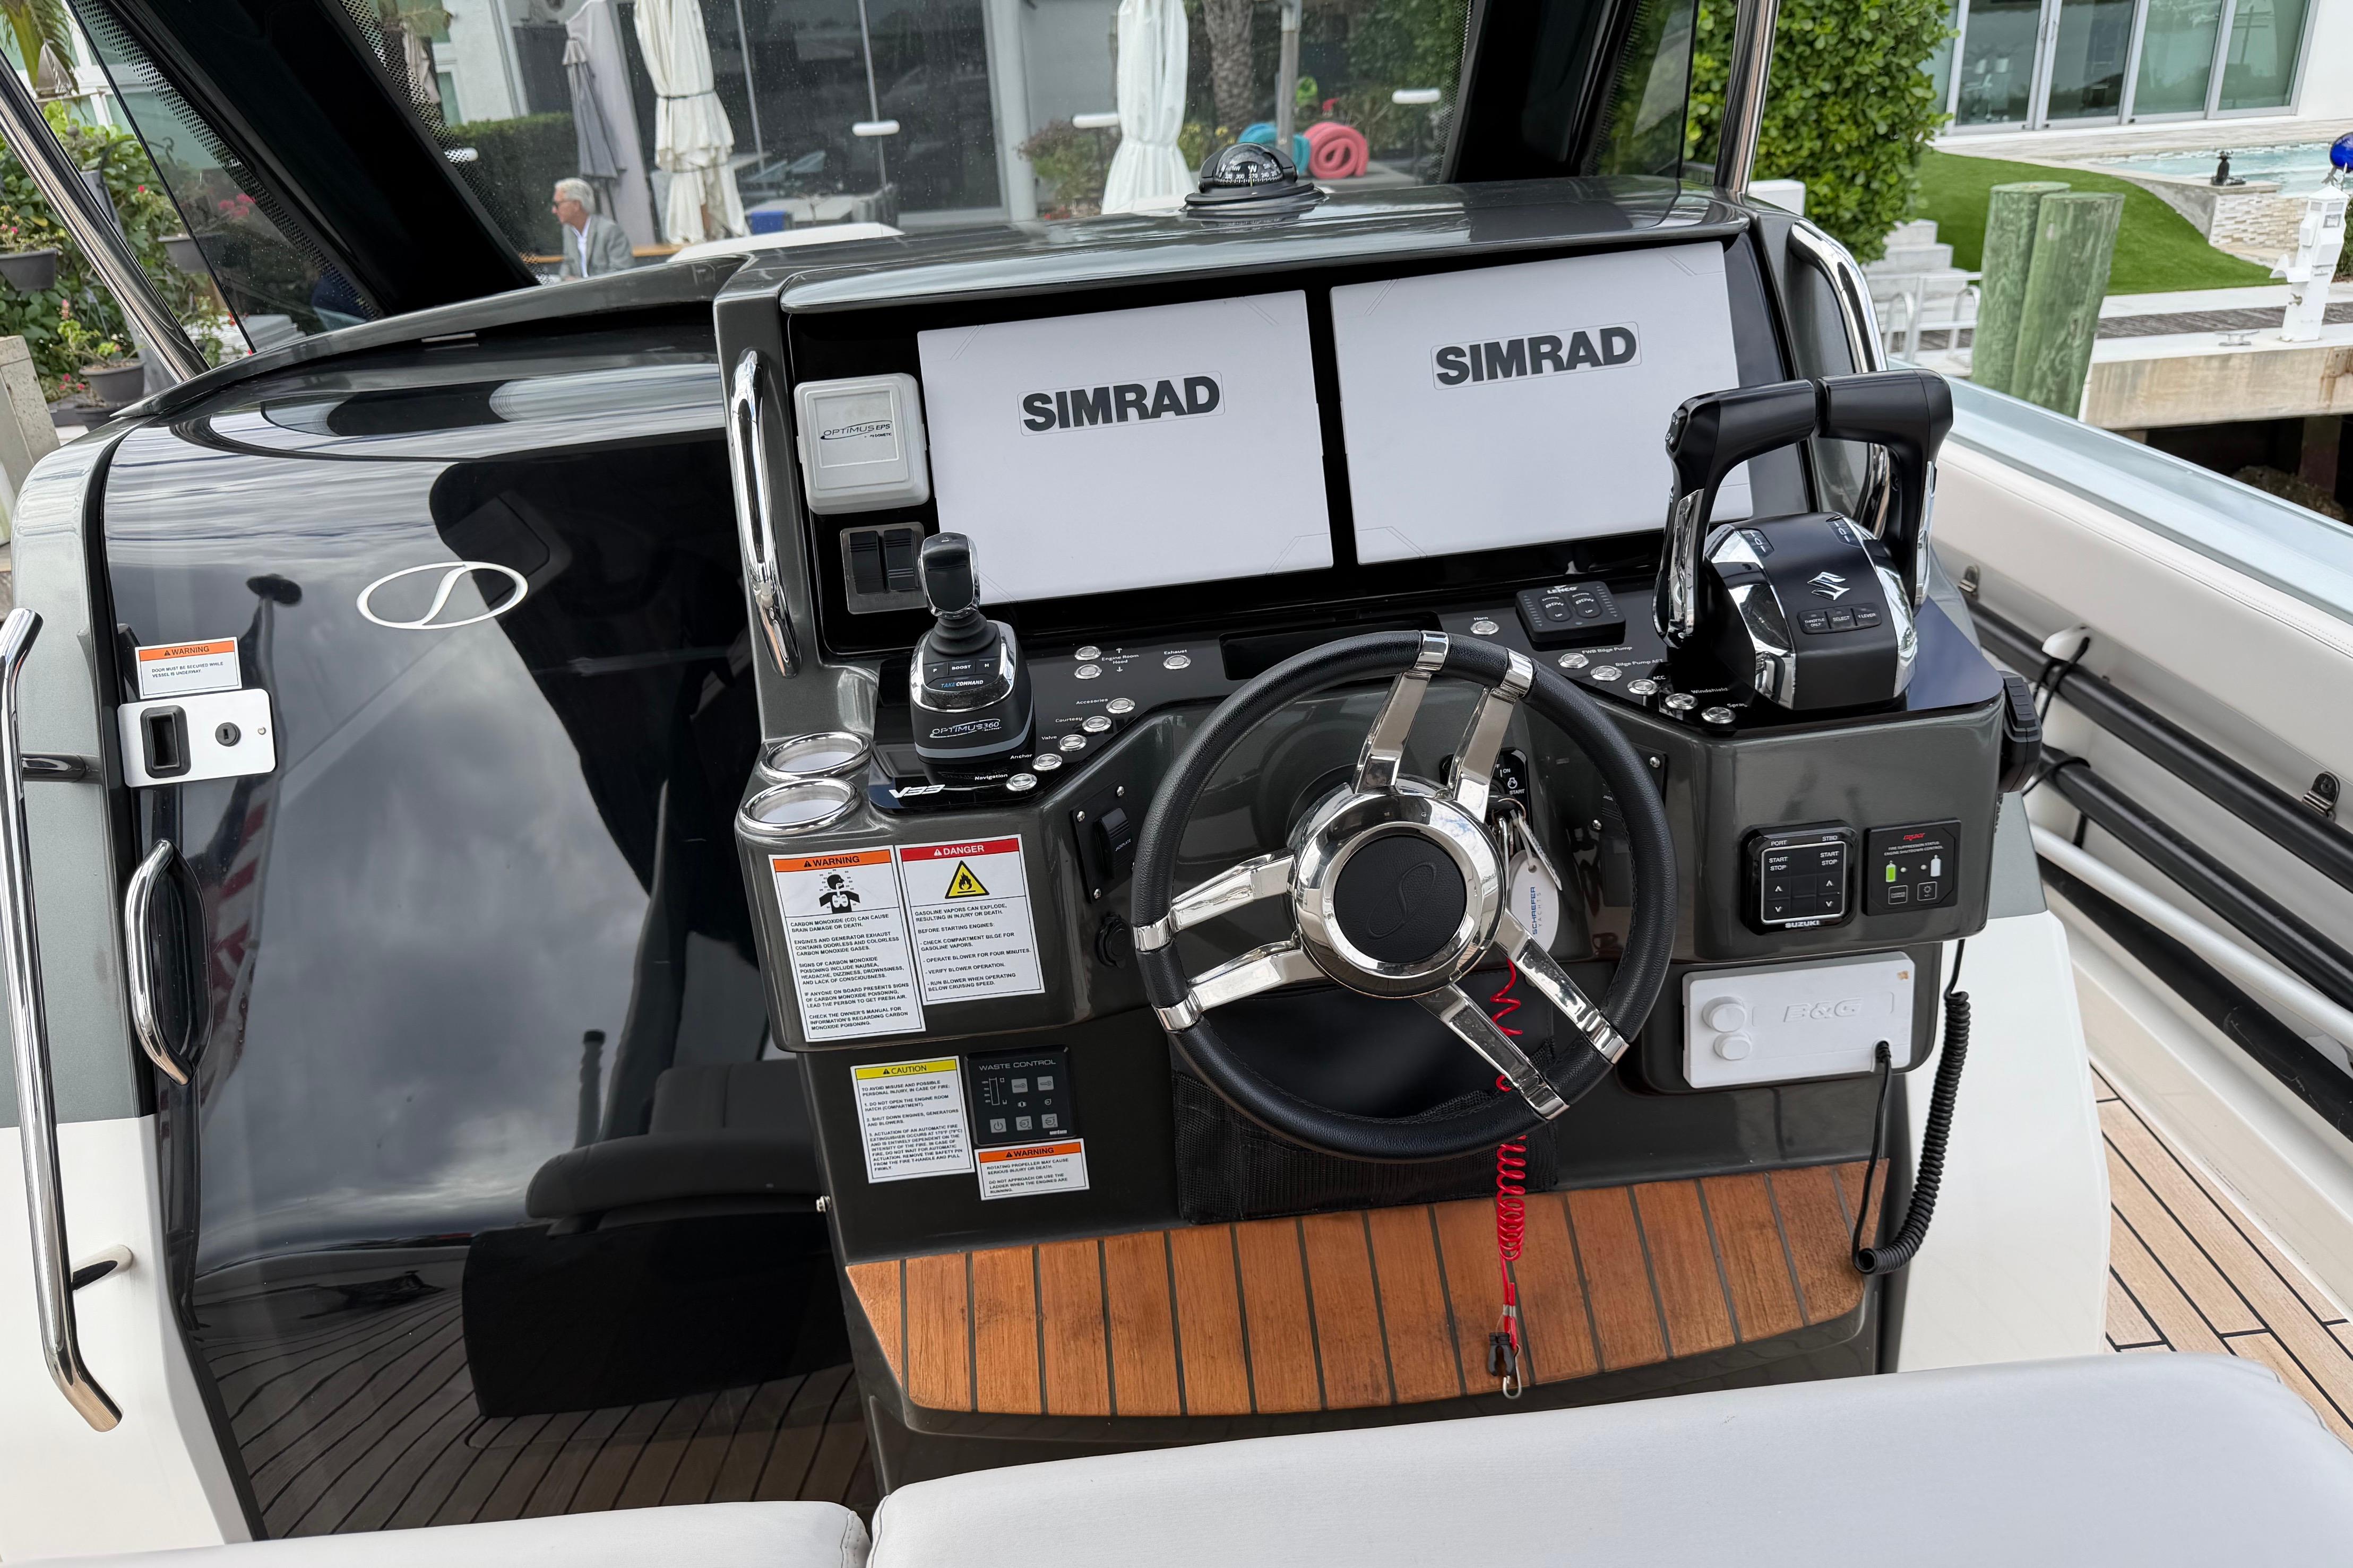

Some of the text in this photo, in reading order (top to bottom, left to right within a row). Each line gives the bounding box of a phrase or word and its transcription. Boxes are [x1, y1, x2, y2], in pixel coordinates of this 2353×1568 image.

[1436, 327, 1636, 385] SIMRAD
[1023, 377, 1220, 431] SIMRAD
[171, 646, 209, 655] WARNING
[889, 784, 945, 798] V33
[943, 844, 985, 855] DANGER
[812, 855, 860, 867] WARNING
[979, 903, 1007, 911] EXPLODE,
[1785, 920, 1820, 929] SUZUKI
[942, 934, 985, 943] COMPARTMENT
[1783, 998, 1862, 1023] B&G
[809, 1017, 851, 1025] INFORMATION'S
[1013, 1059, 1056, 1068] CONTROL
[891, 1064, 927, 1075] CAUTION
[1013, 1147, 1054, 1157] WARNING
